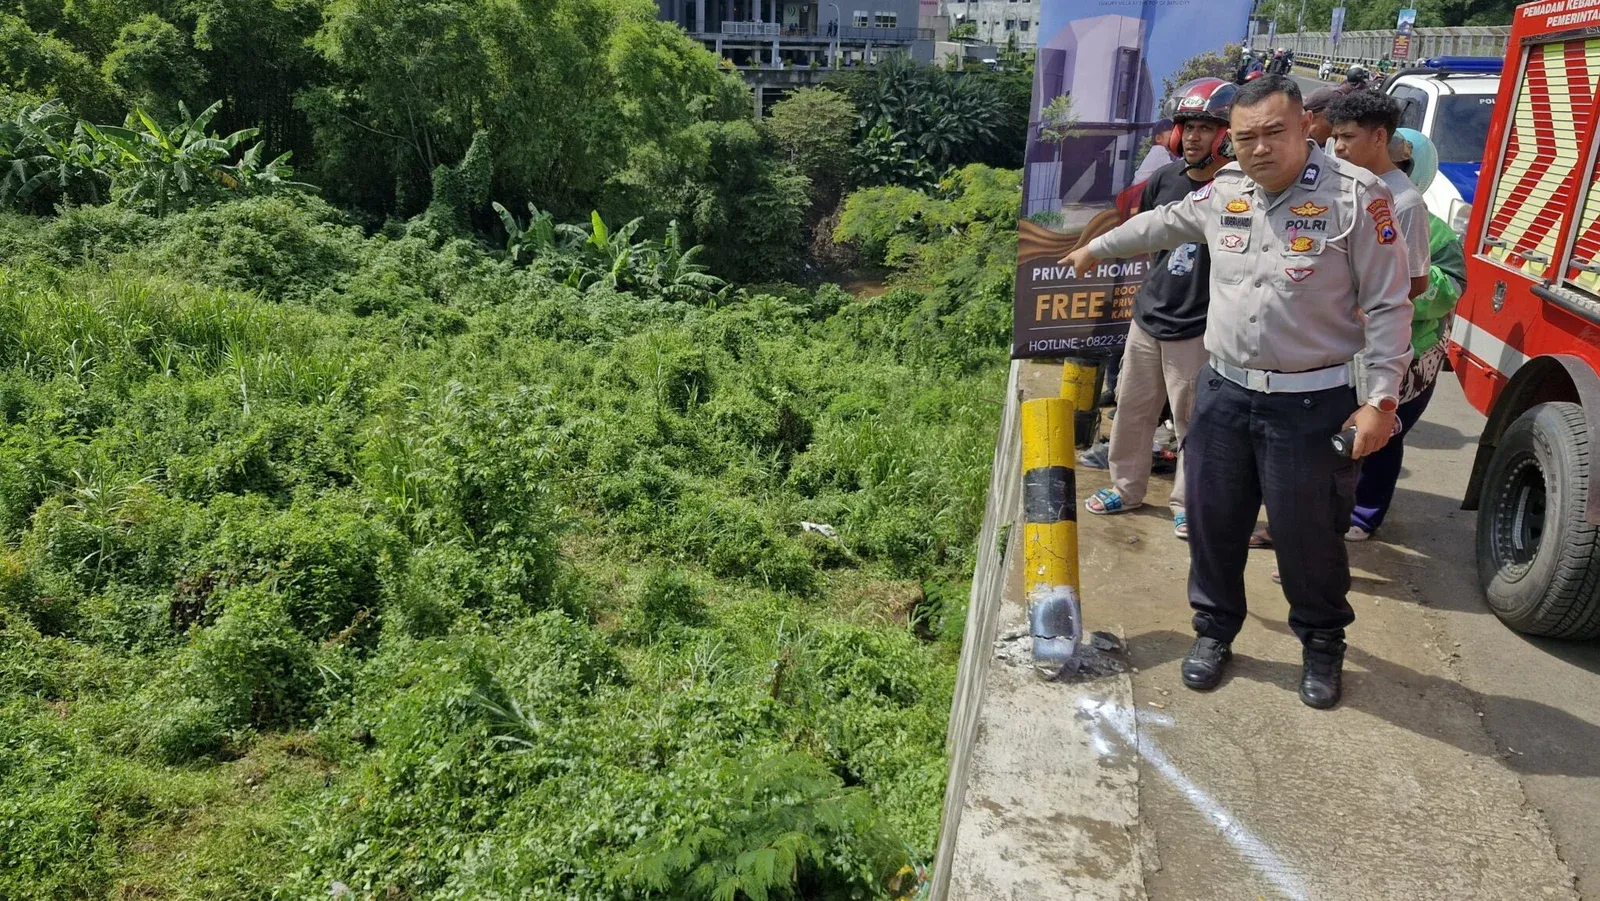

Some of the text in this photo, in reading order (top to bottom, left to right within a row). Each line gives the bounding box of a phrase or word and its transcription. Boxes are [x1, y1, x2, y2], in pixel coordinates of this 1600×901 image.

[1523, 1, 1565, 17] PEMADAM
[1285, 219, 1327, 231] POLRI
[1032, 266, 1091, 281] PRIVAE
[1097, 261, 1142, 278] HOME
[1036, 291, 1105, 321] FREE
[1029, 338, 1079, 352] HOTLINE
